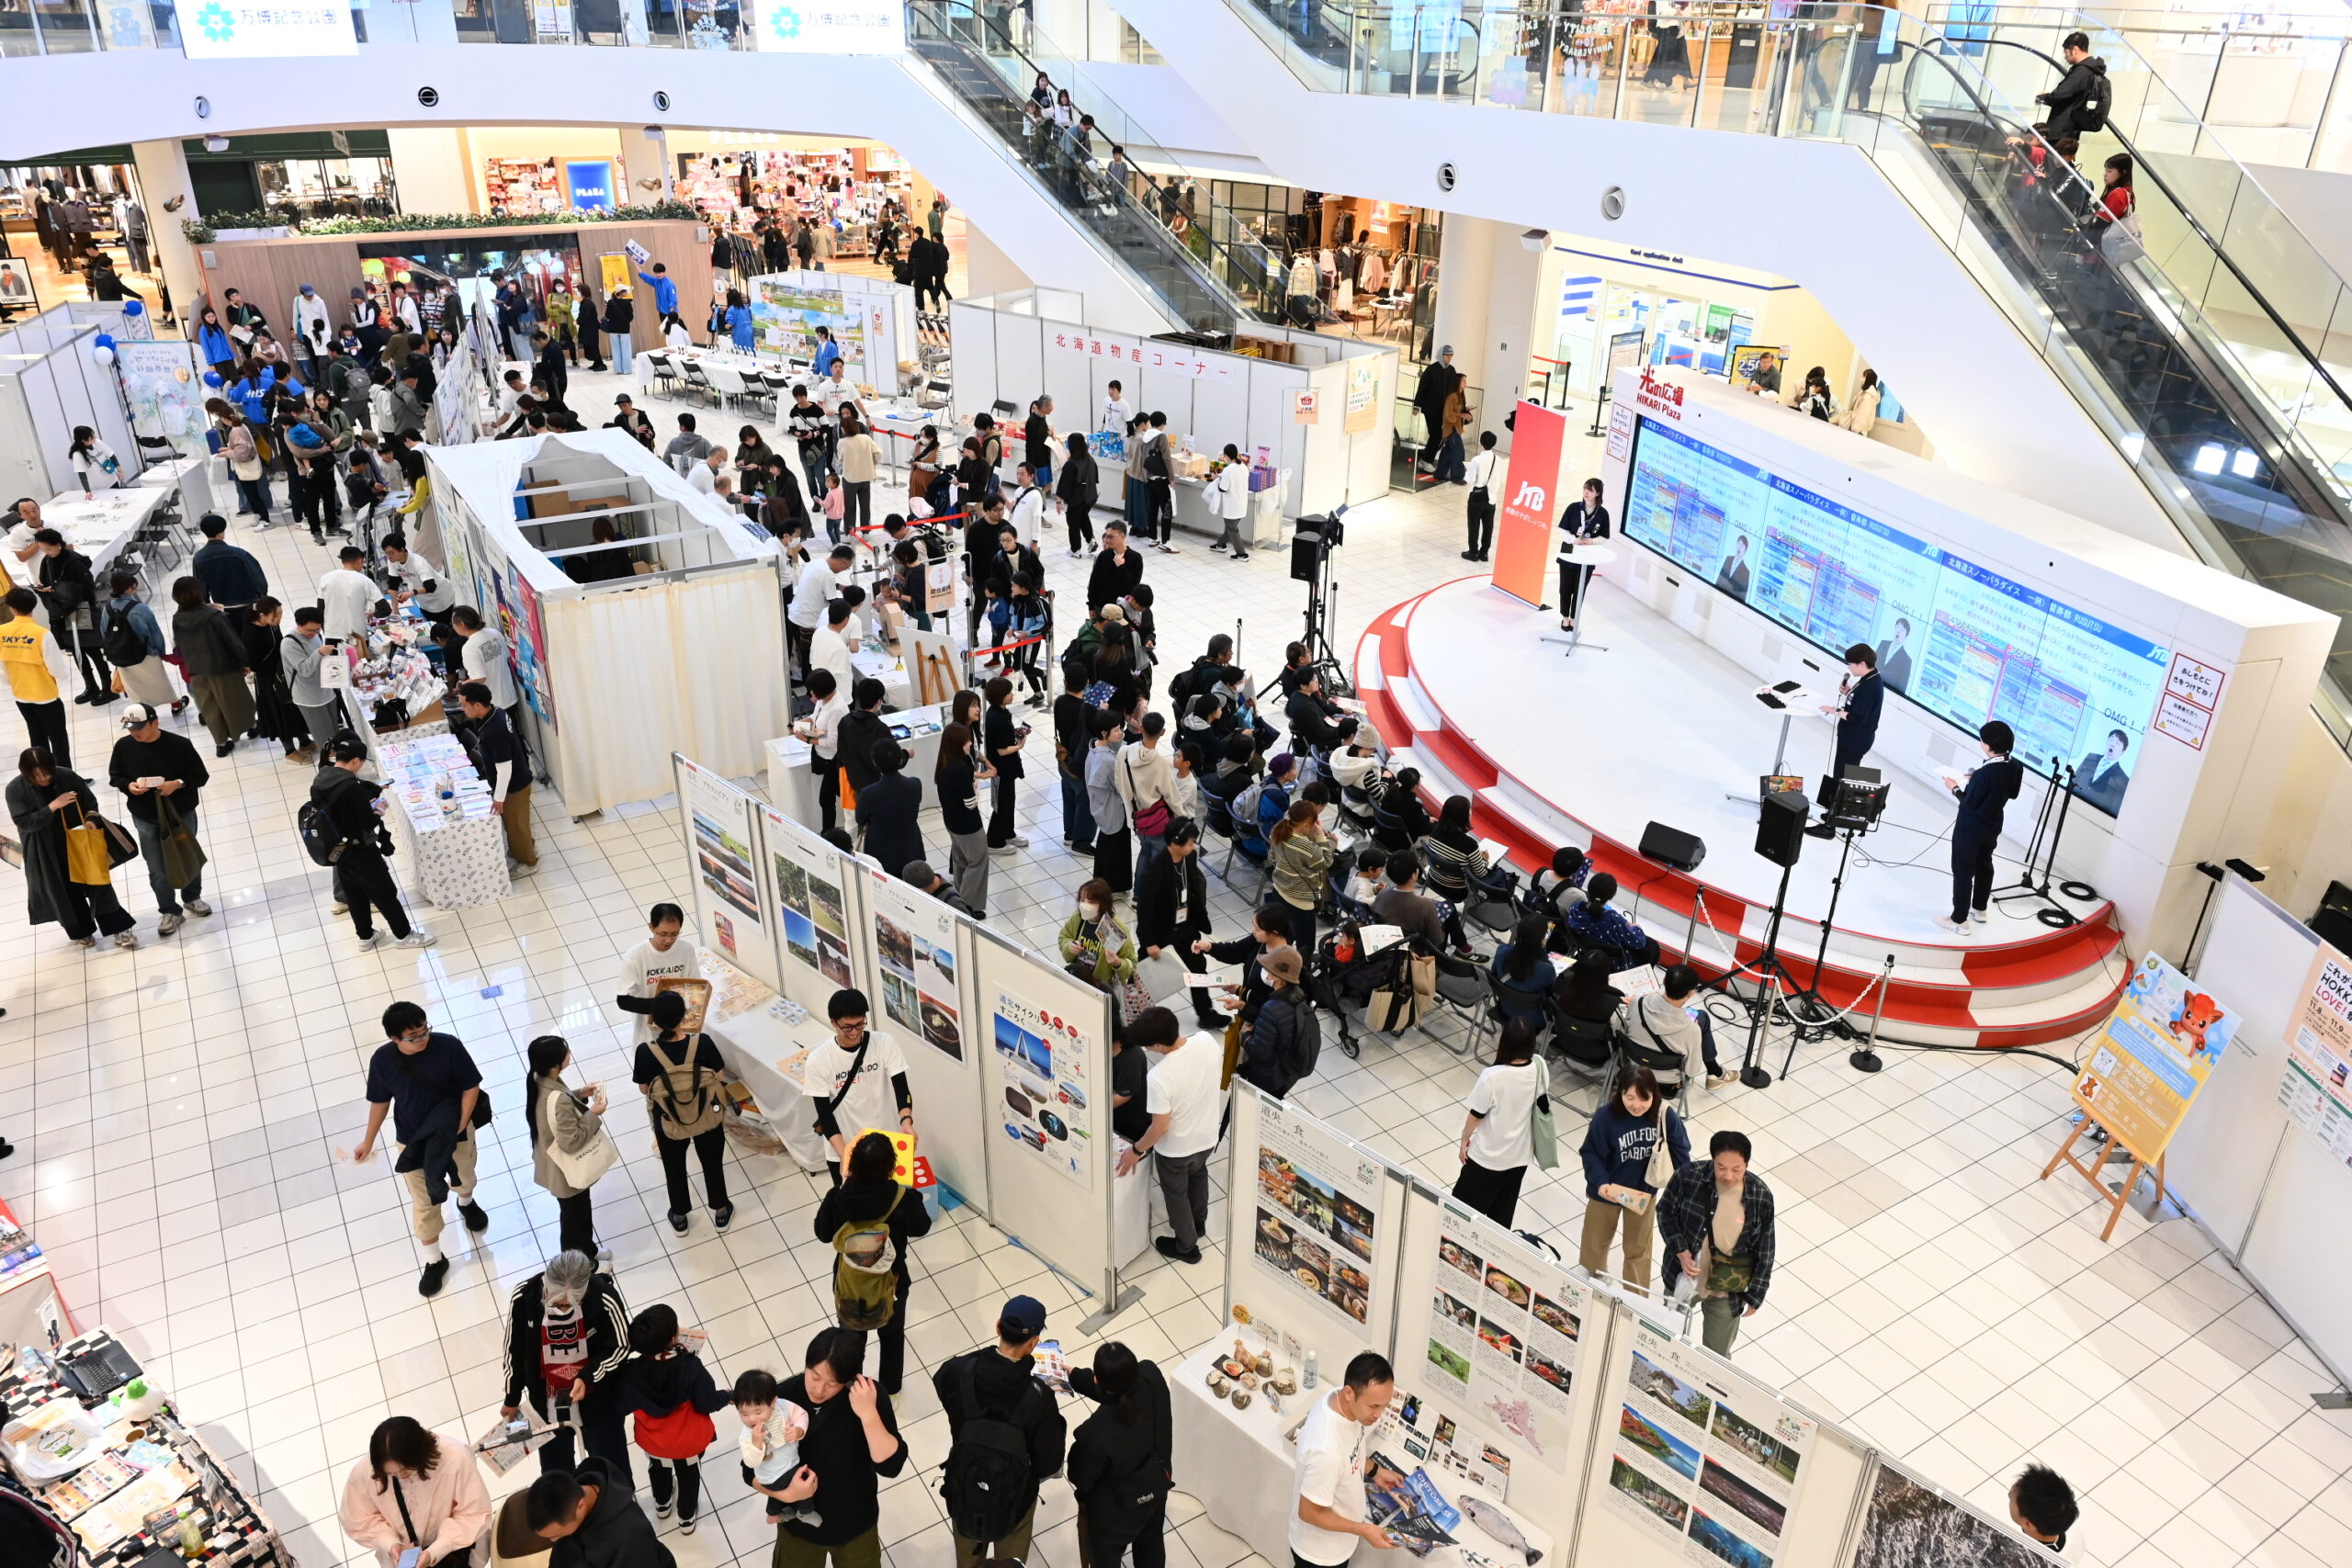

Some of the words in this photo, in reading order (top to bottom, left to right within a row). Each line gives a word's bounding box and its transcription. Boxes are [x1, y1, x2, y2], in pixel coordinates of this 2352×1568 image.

[240, 9, 337, 25] 万博記念公園
[806, 13, 891, 28] 万博記念公園
[575, 187, 605, 197] PLAZA
[1056, 333, 1228, 375] 北海道物産コーナー
[244, 389, 266, 399] HIS
[1639, 364, 1685, 408] 光の広場
[1636, 392, 1661, 412] HIKARI
[1661, 403, 1682, 421] Plaza
[1511, 480, 1546, 513] JTB
[1774, 479, 1831, 511] 北海道スノーパラダイス
[1920, 543, 1940, 558] JTB
[930, 584, 952, 595] 総合案内
[1947, 556, 2021, 597] 北海道スノーパラダイス
[2073, 613, 2104, 635] RUSUTSU
[2, 636, 21, 644] SKY
[2146, 645, 2169, 663] JTB
[2180, 667, 2212, 686] あしもとに
[702, 781, 730, 803] アクティビティ
[1000, 1005, 1026, 1027] すごろく
[835, 1076, 861, 1089] LOE!
[1261, 1104, 1283, 1124] 道央
[1294, 1124, 1306, 1139] 食
[1618, 1126, 1657, 1152] MULFOR
[1621, 1145, 1653, 1163] GARDE
[1442, 1213, 1461, 1231] 道央
[1470, 1231, 1480, 1241] 食
[1636, 1330, 1658, 1348] 道央
[1669, 1351, 1681, 1363] 食
[1417, 1472, 1445, 1508] CHITOSE
